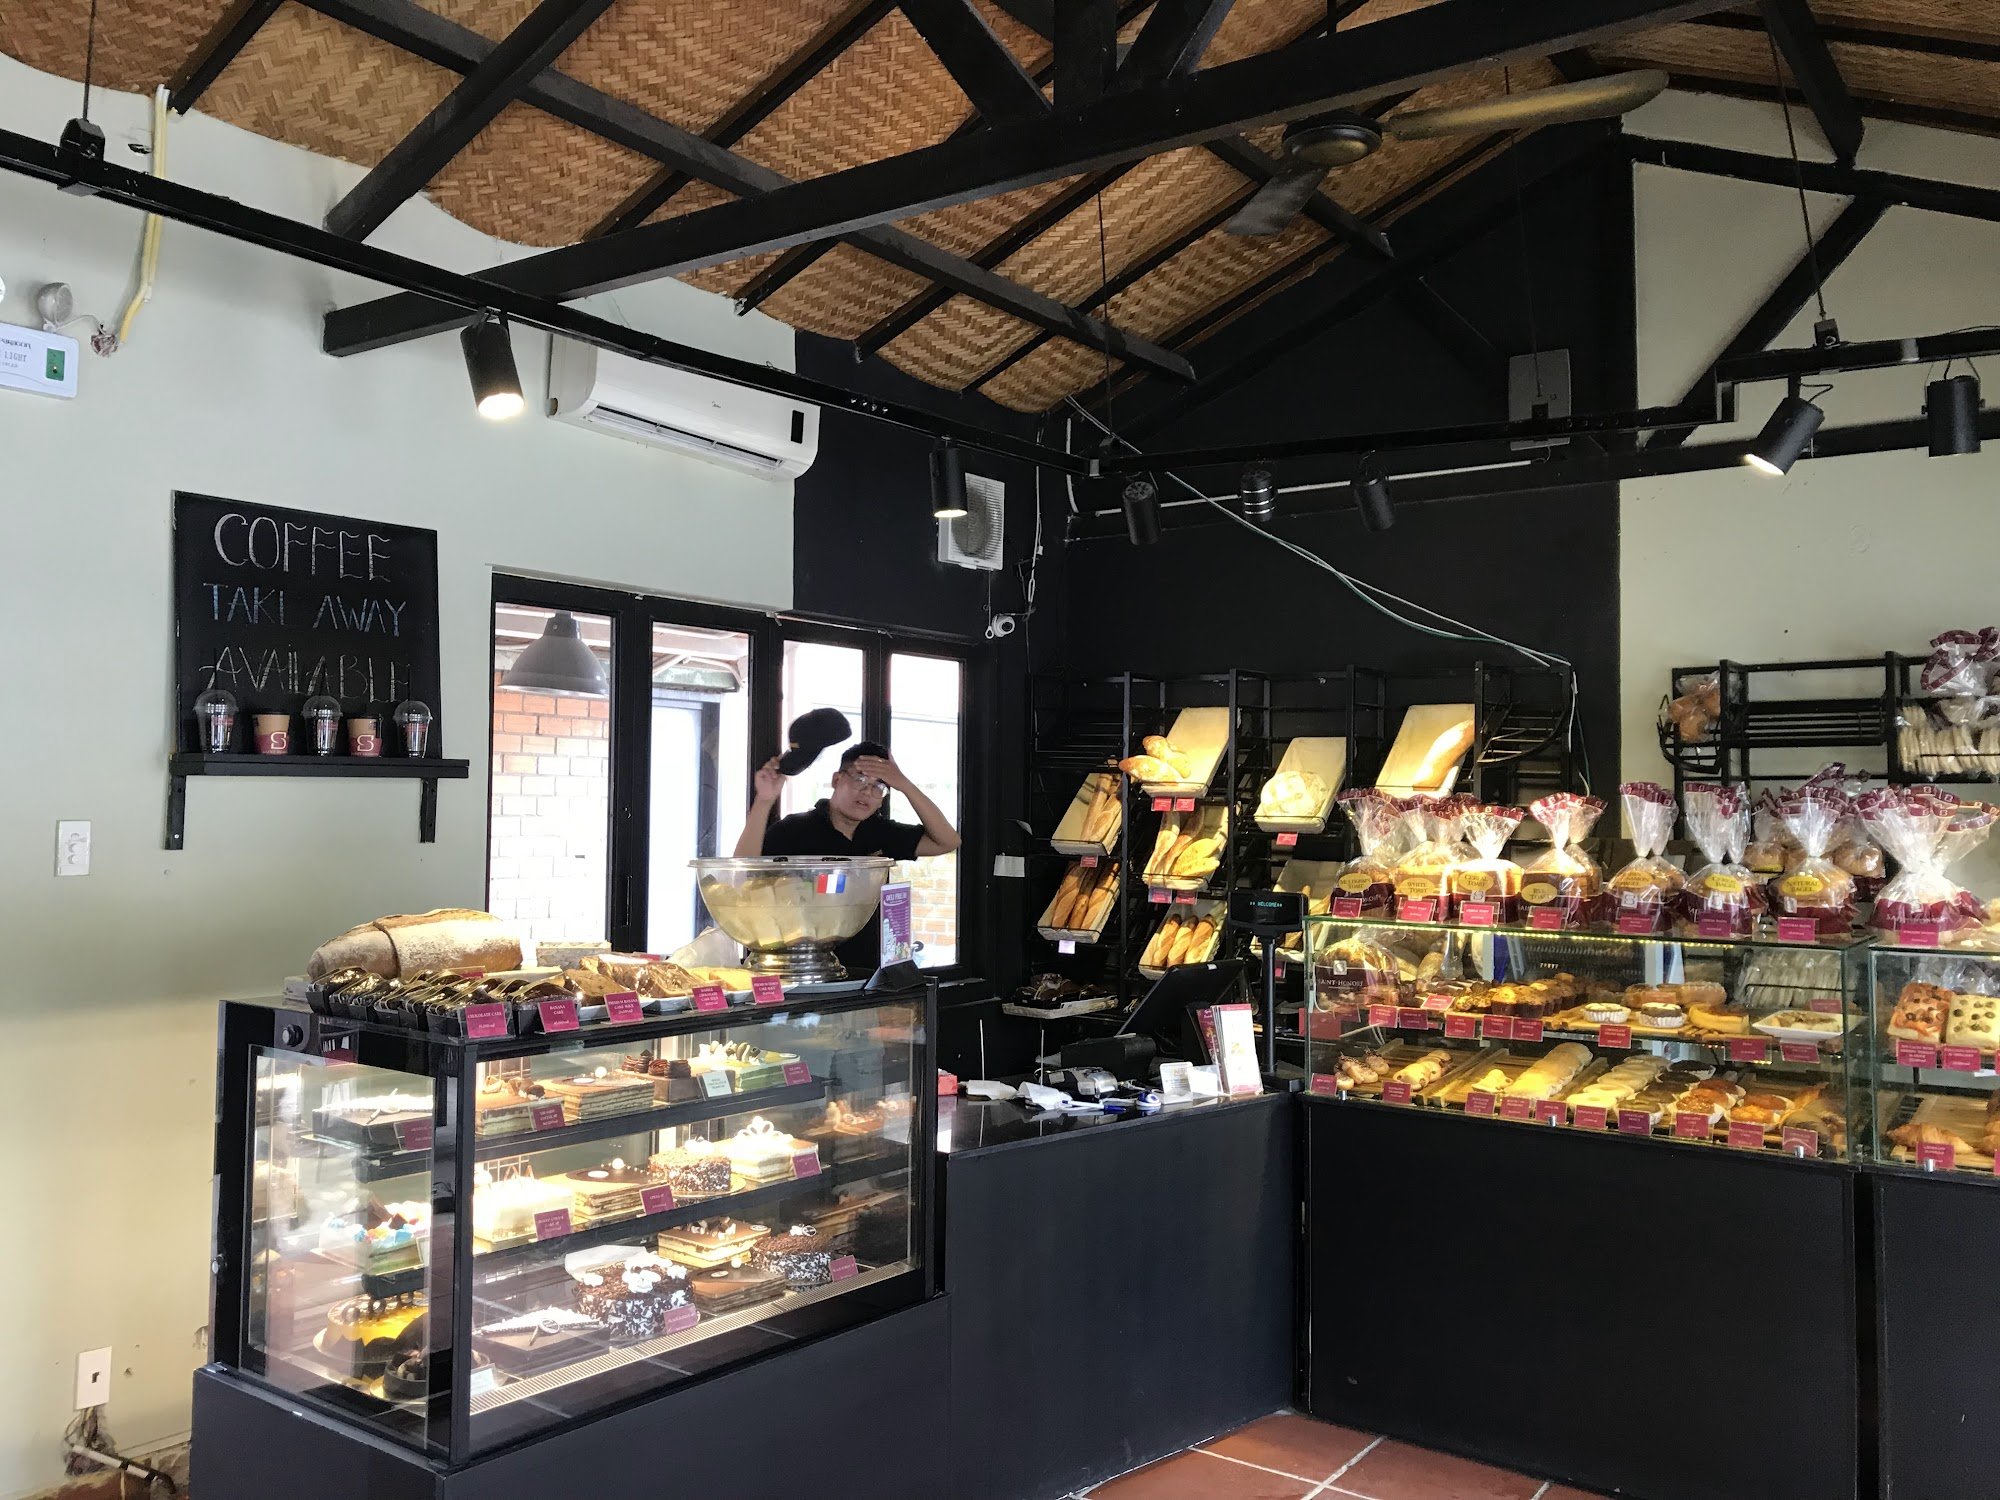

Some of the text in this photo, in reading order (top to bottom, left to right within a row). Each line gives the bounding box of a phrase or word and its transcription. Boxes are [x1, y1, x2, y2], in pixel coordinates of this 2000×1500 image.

[214, 513, 391, 583] COFFEE
[312, 595, 407, 637] AWAY
[199, 643, 411, 703] AVAILABLE
[270, 732, 287, 750] S
[357, 734, 375, 752] S
